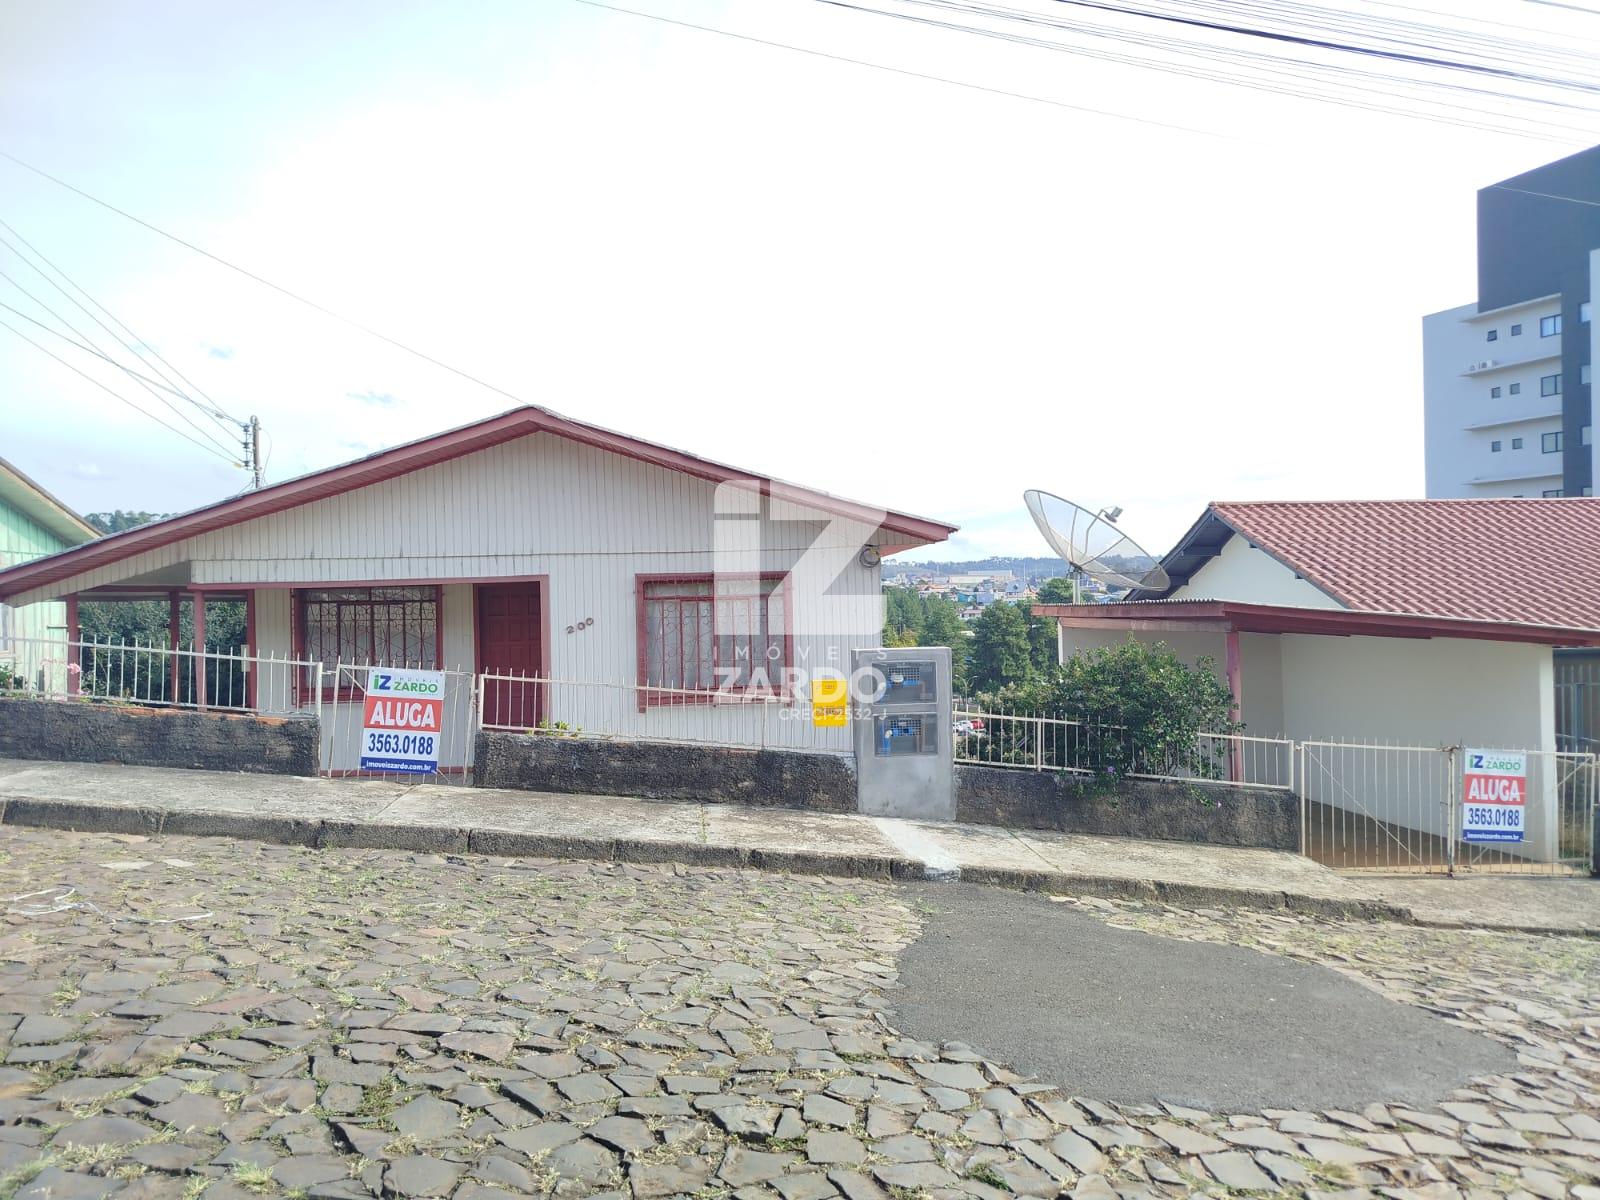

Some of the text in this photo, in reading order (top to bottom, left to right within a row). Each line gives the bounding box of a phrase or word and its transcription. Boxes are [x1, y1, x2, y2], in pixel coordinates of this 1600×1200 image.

[566, 617, 594, 634] 200
[393, 681, 438, 693] ZARDO
[369, 700, 436, 728] ALUGA
[368, 732, 434, 756] 3563.0188
[1486, 760, 1521, 771] ZARDO
[1468, 777, 1521, 802] ALUGA
[1468, 807, 1520, 827] 3563.0188
